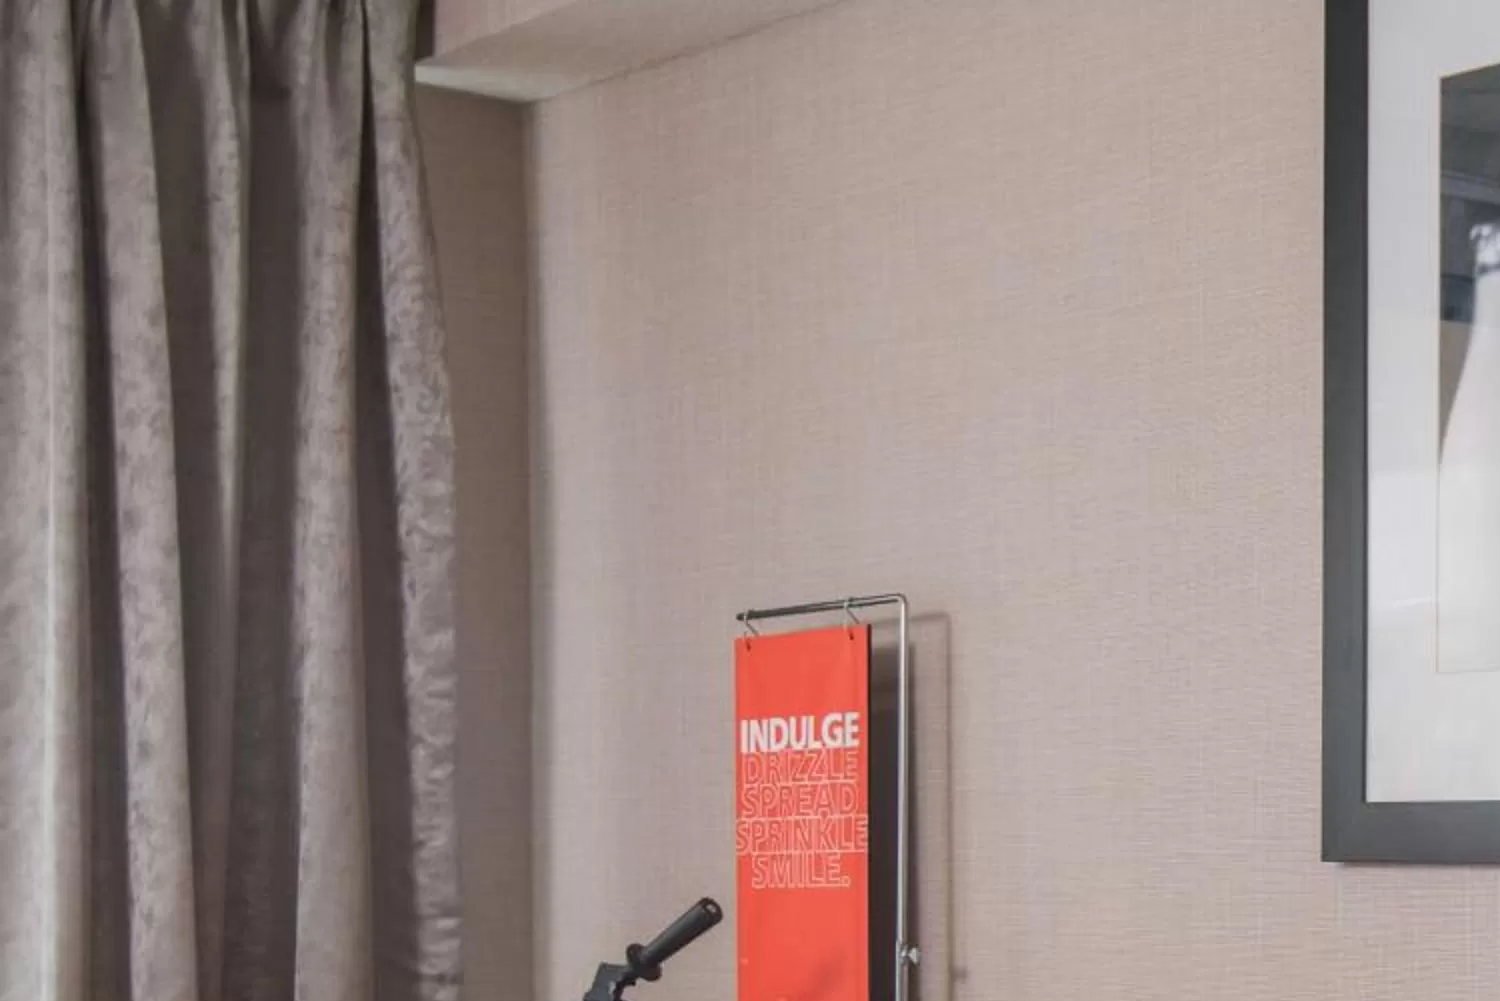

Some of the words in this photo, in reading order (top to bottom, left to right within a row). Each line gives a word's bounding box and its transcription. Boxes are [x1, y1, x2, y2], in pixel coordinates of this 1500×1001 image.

[740, 711, 861, 754] INDULGE
[743, 749, 859, 784] DRIZZLE
[743, 781, 859, 819] SPREAD
[735, 815, 868, 854] SPRINKLE
[751, 852, 852, 888] SMILE.
